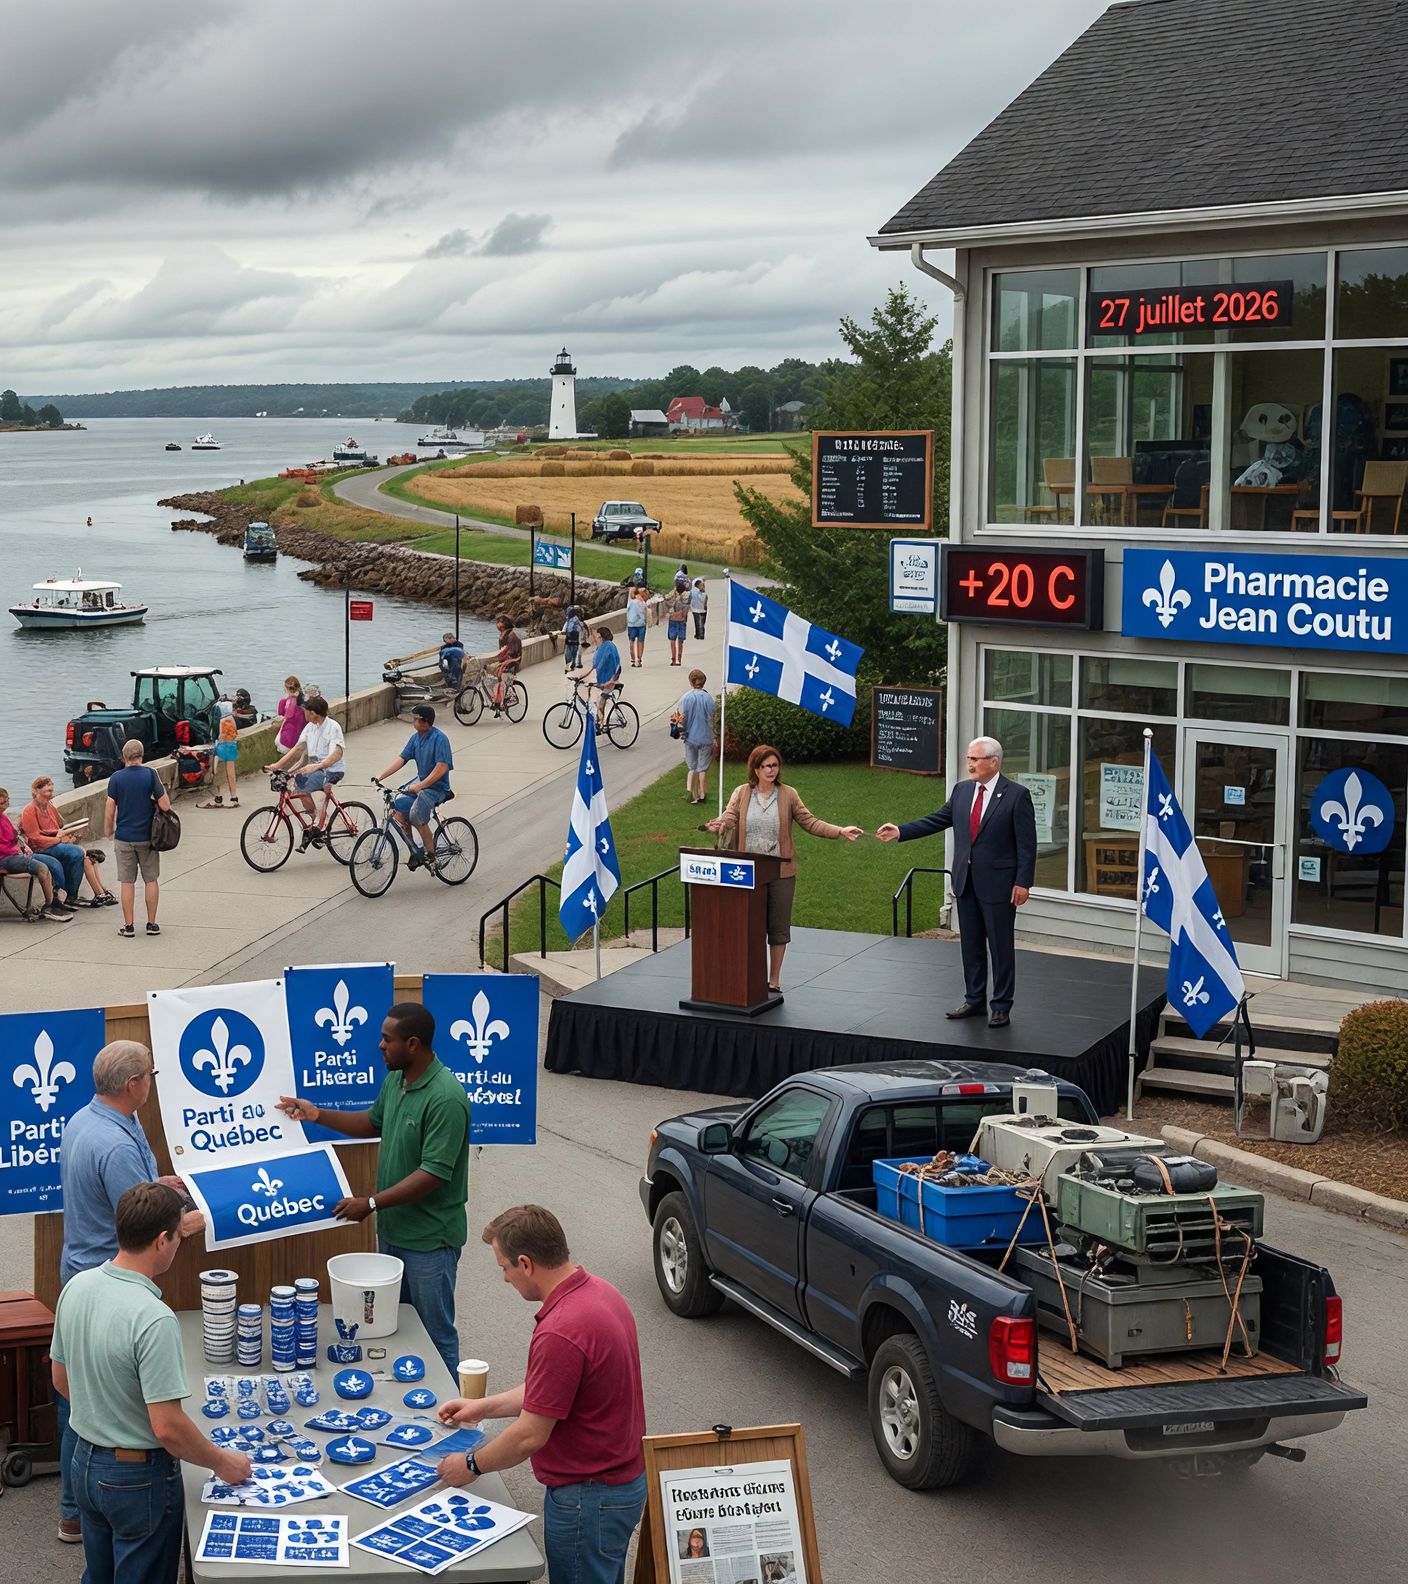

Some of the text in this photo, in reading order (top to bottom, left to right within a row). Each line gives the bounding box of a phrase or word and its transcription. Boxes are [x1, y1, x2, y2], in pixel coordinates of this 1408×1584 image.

[1099, 290, 1279, 334] 27 juillet 2026
[959, 562, 1035, 608] +20
[1048, 565, 1076, 610] C
[1204, 562, 1390, 602] Pharmacie
[1199, 599, 1393, 641] Jean Coutu
[447, 1066, 490, 1085] arti
[10, 1116, 66, 1141] Parti
[182, 1103, 235, 1127] Parti
[190, 1124, 283, 1153] Québec
[237, 1194, 325, 1227] Québec
